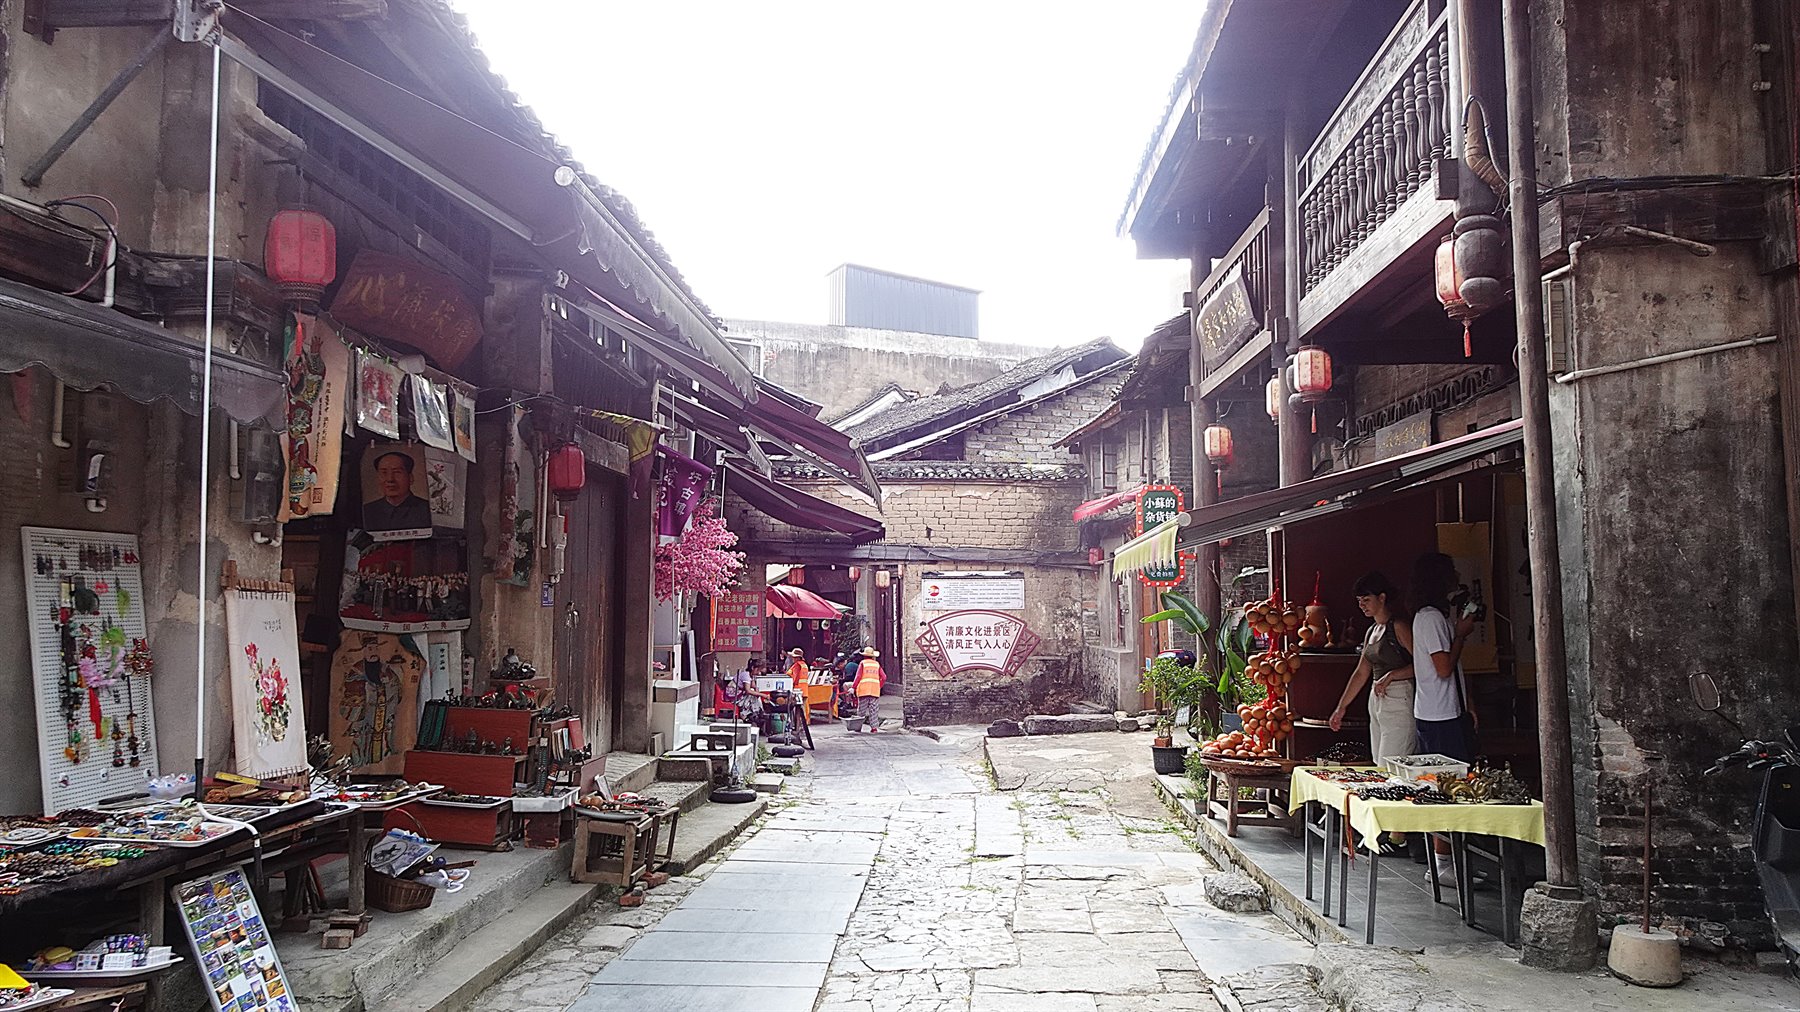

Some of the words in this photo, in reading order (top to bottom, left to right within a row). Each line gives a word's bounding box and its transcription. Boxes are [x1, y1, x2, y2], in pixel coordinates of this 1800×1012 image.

[1144, 497, 1175, 509] 小蘇的
[382, 622, 448, 631] 开国大典
[945, 625, 1011, 637] 清廉文化进景区
[945, 639, 1011, 650] 清风正气入人心
